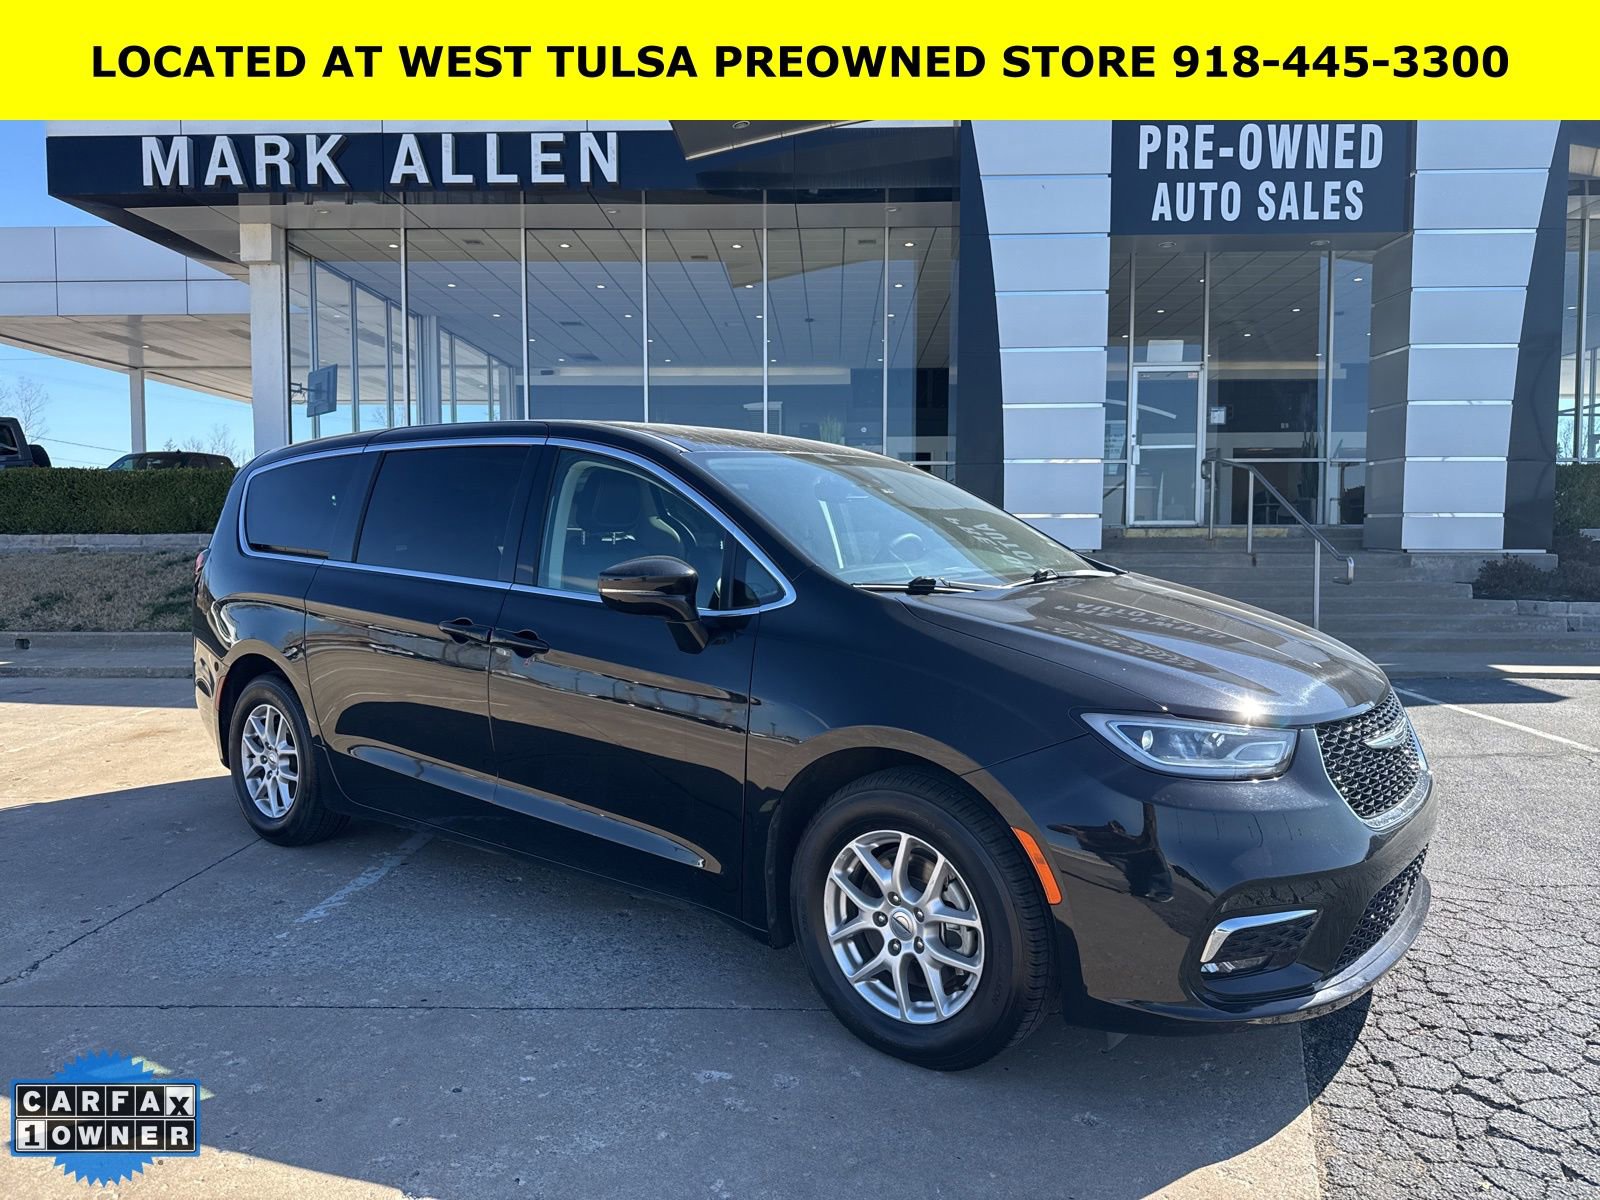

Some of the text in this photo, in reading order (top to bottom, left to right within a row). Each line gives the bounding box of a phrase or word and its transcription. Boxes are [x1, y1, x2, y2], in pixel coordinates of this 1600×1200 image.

[141, 132, 619, 187] MARK ALLEN
[1138, 123, 1383, 170] PRE-OWNED
[1151, 180, 1364, 222] AUTO SALES
